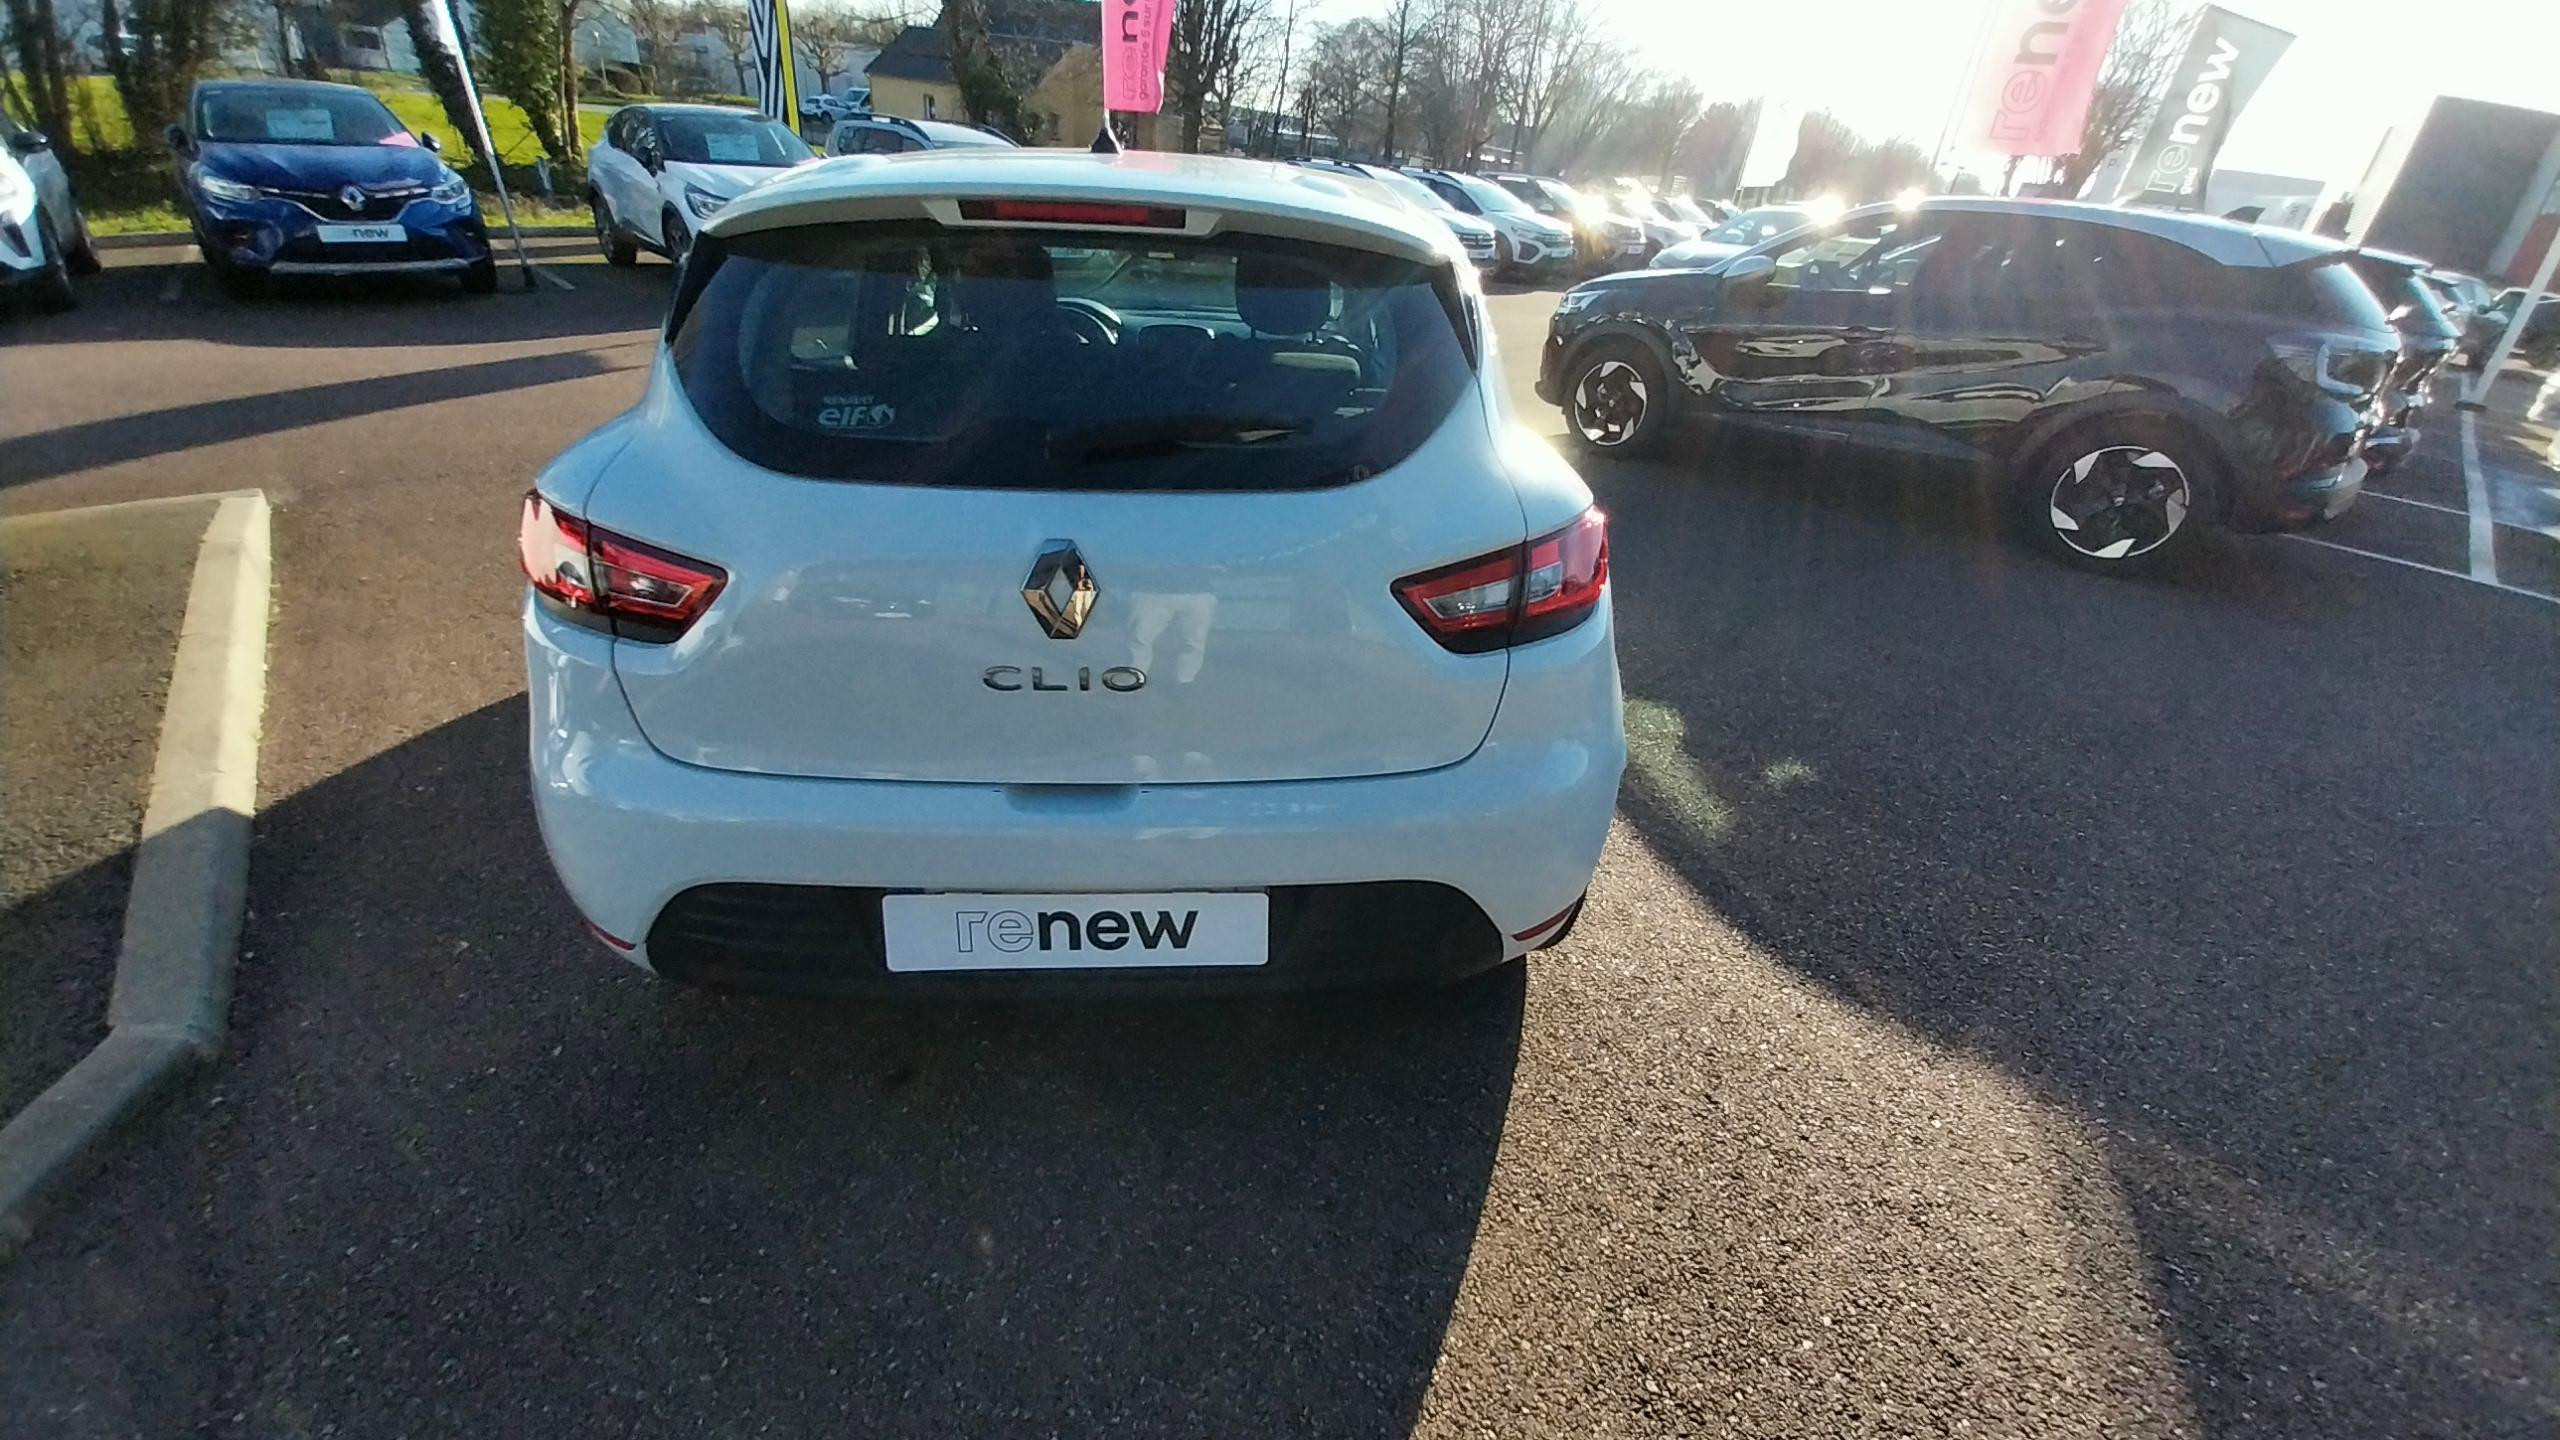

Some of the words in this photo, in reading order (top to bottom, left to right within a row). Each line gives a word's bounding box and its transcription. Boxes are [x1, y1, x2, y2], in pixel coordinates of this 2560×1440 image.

[1139, 42, 1150, 101] garantie
[2143, 35, 2240, 194] renew
[818, 406, 868, 426] elf
[983, 665, 1148, 692] CLIO
[955, 910, 1199, 953] renew
